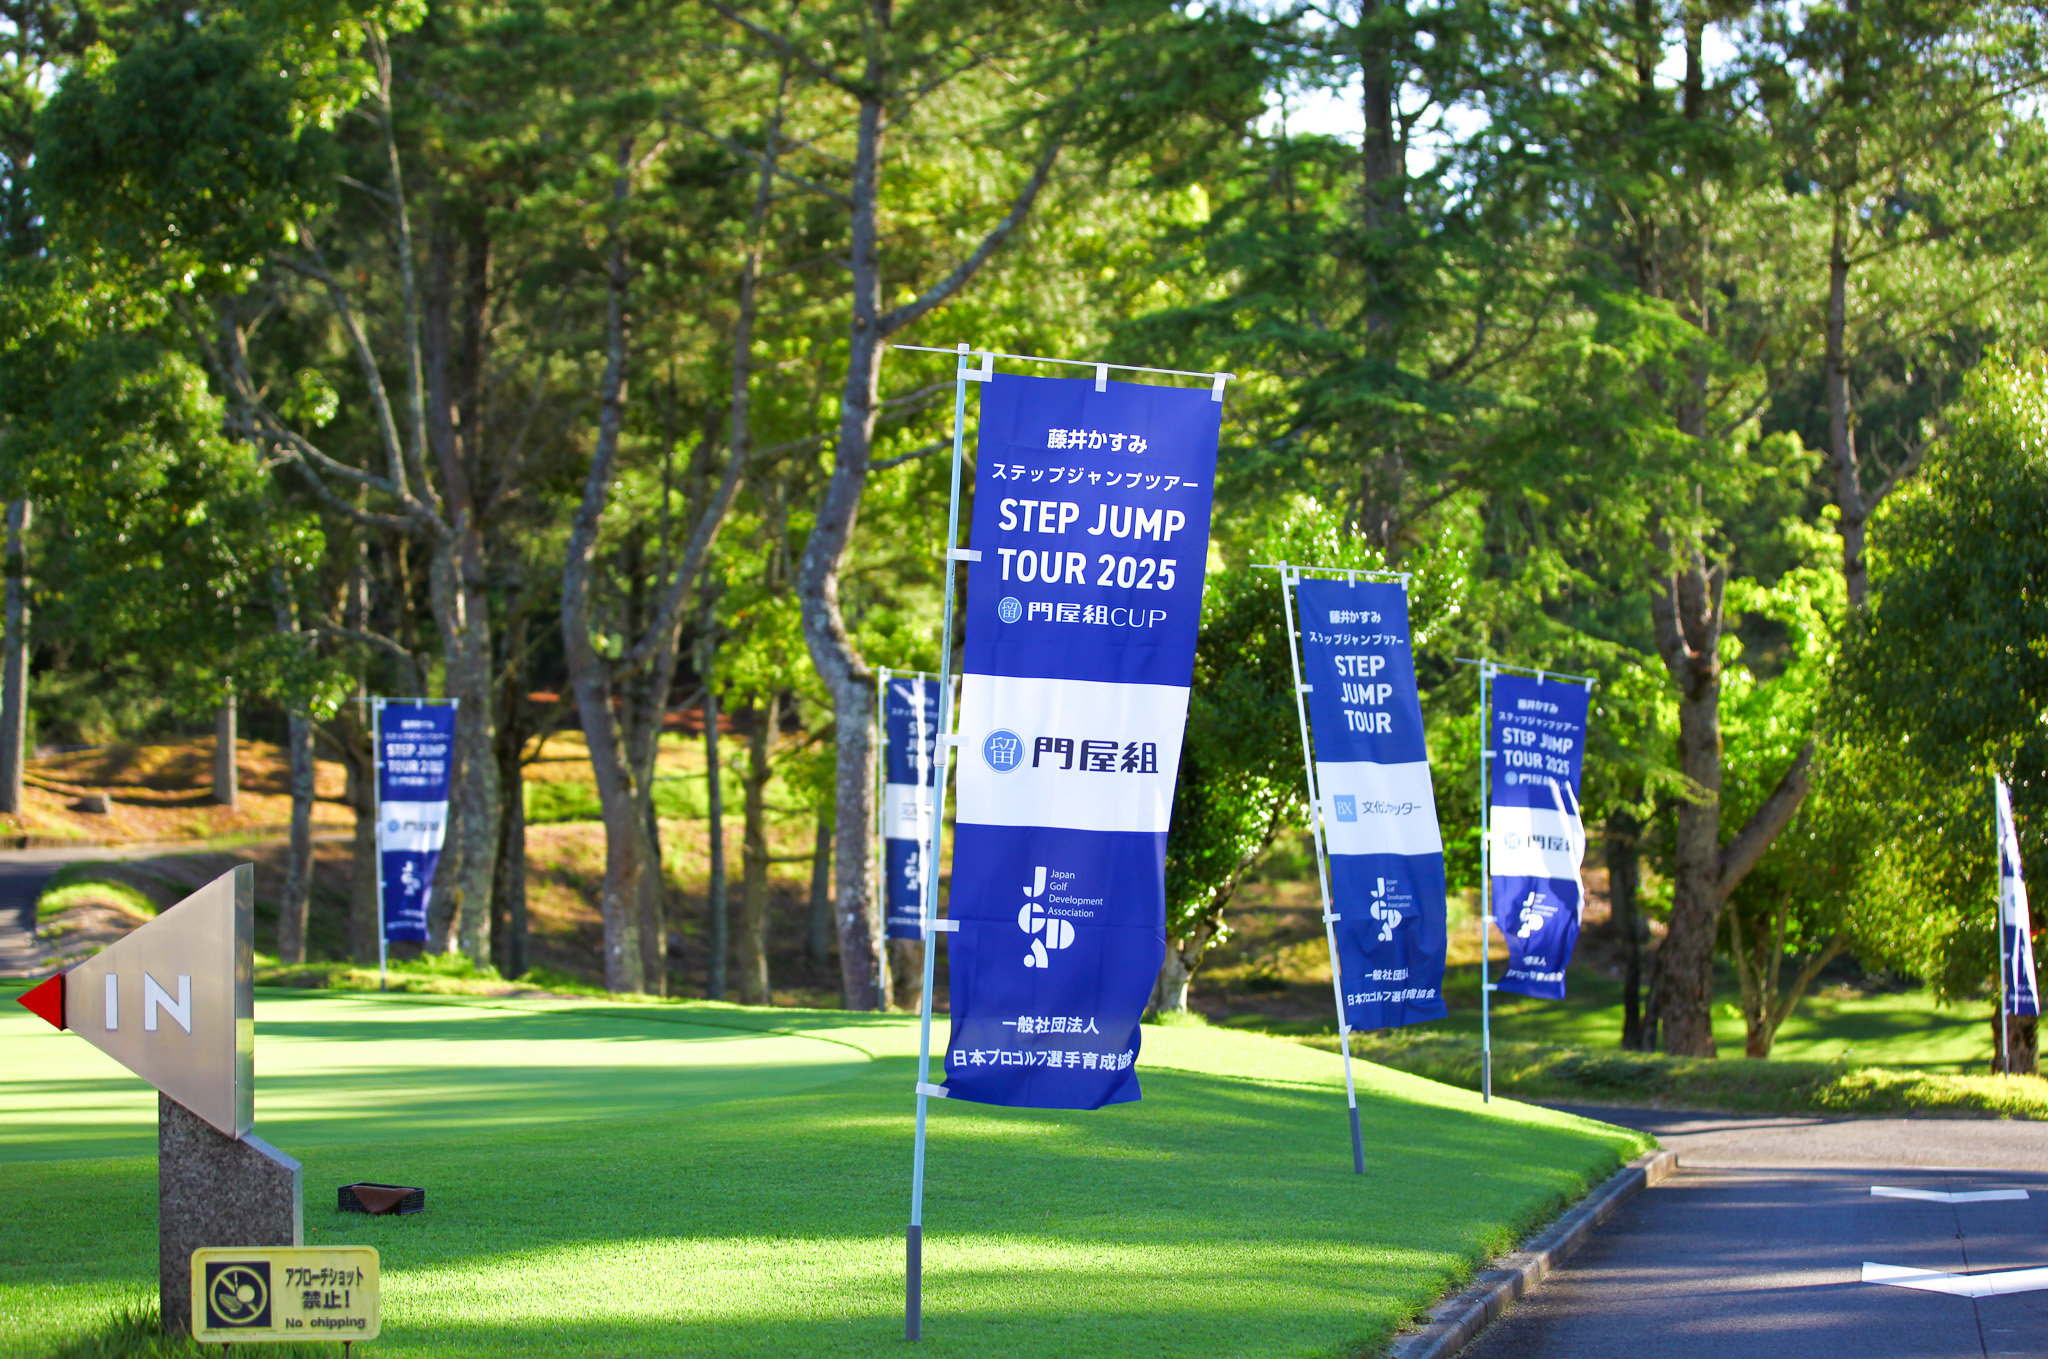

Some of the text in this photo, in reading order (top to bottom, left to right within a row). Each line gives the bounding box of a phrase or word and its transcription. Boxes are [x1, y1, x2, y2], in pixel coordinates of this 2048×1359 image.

[1047, 428, 1148, 454] 藤井かすみ
[991, 463, 1199, 491] ステップジャンプツアー
[998, 497, 1186, 541] STEP JUMP
[997, 547, 1177, 590] TOUR 2025
[1334, 655, 1385, 677] STEP
[1341, 682, 1393, 705] JUMP
[1343, 709, 1392, 734] TOUR
[386, 743, 416, 758] STEP
[1502, 727, 1574, 754] STEP JUMP
[1032, 736, 1159, 774] 門屋組
[1503, 749, 1543, 769] TOUR
[1050, 869, 1075, 880] Japan
[1049, 881, 1068, 891] Golf
[1048, 893, 1103, 906] Development
[1047, 906, 1094, 917] Association
[105, 971, 192, 1035] IN
[1002, 1015, 1100, 1034] 一般社団法人
[285, 1266, 364, 1287] アプローチショット
[285, 1316, 366, 1330] No chipping
